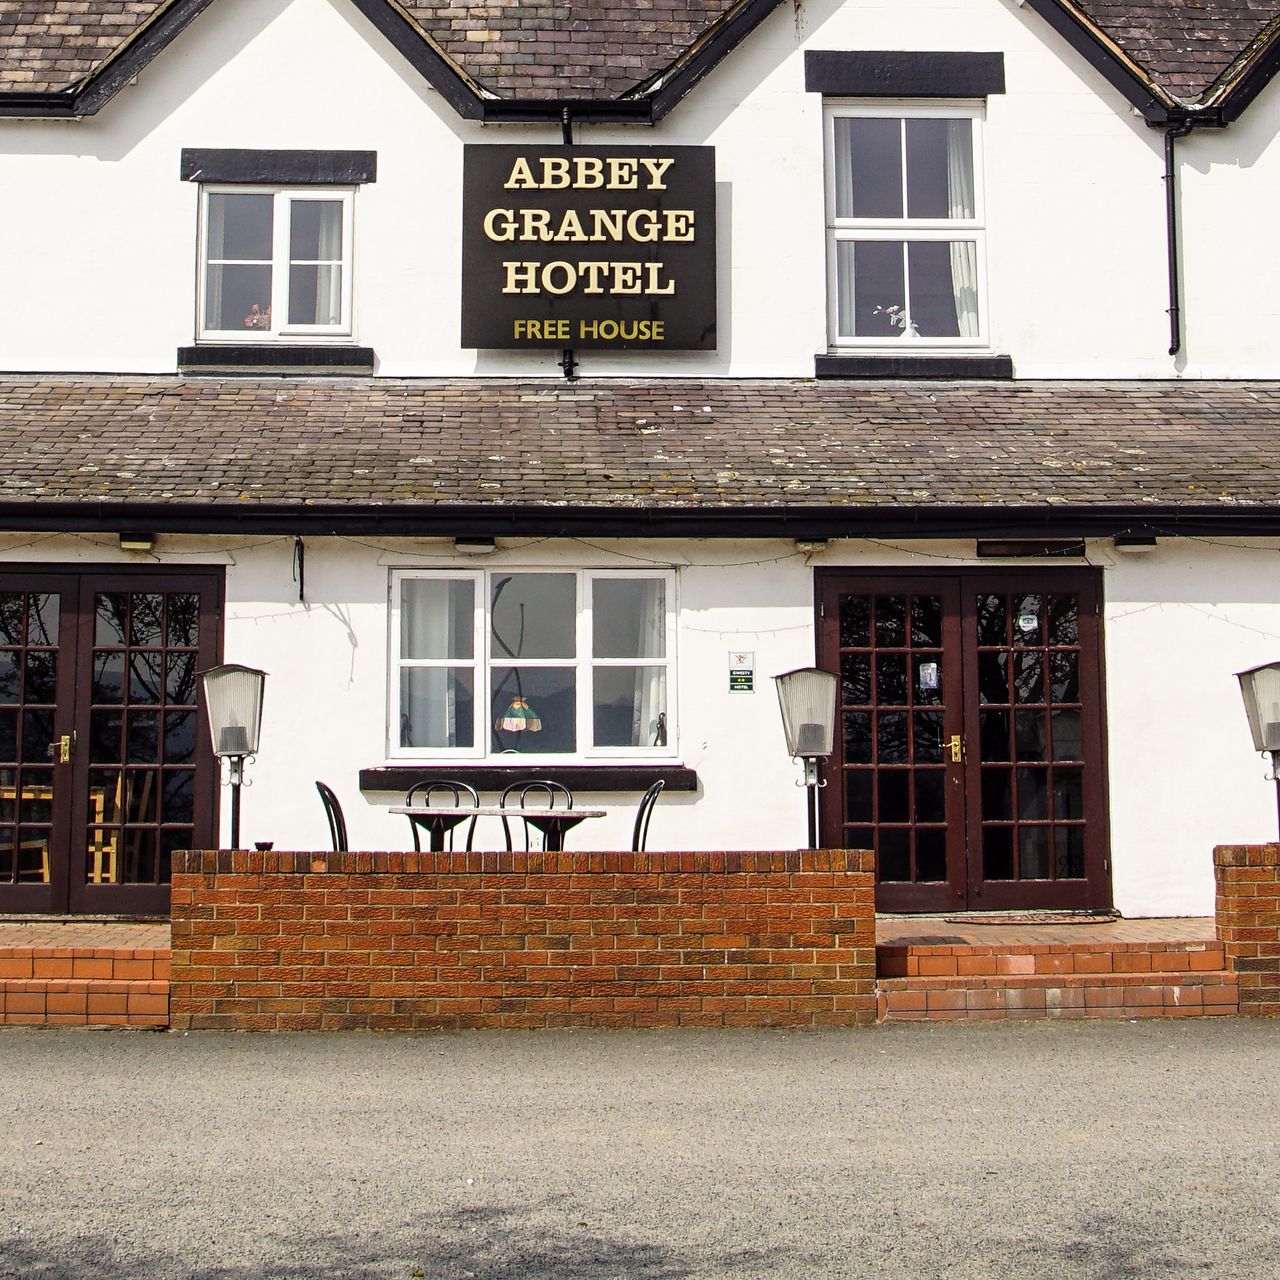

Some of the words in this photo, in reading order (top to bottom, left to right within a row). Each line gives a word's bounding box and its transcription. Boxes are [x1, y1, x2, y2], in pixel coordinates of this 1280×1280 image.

[503, 157, 675, 190] ABBEY
[483, 208, 696, 243] GRANGE
[501, 260, 676, 295] HOTEL
[513, 319, 571, 340] FREE
[579, 319, 665, 341] HOUSE
